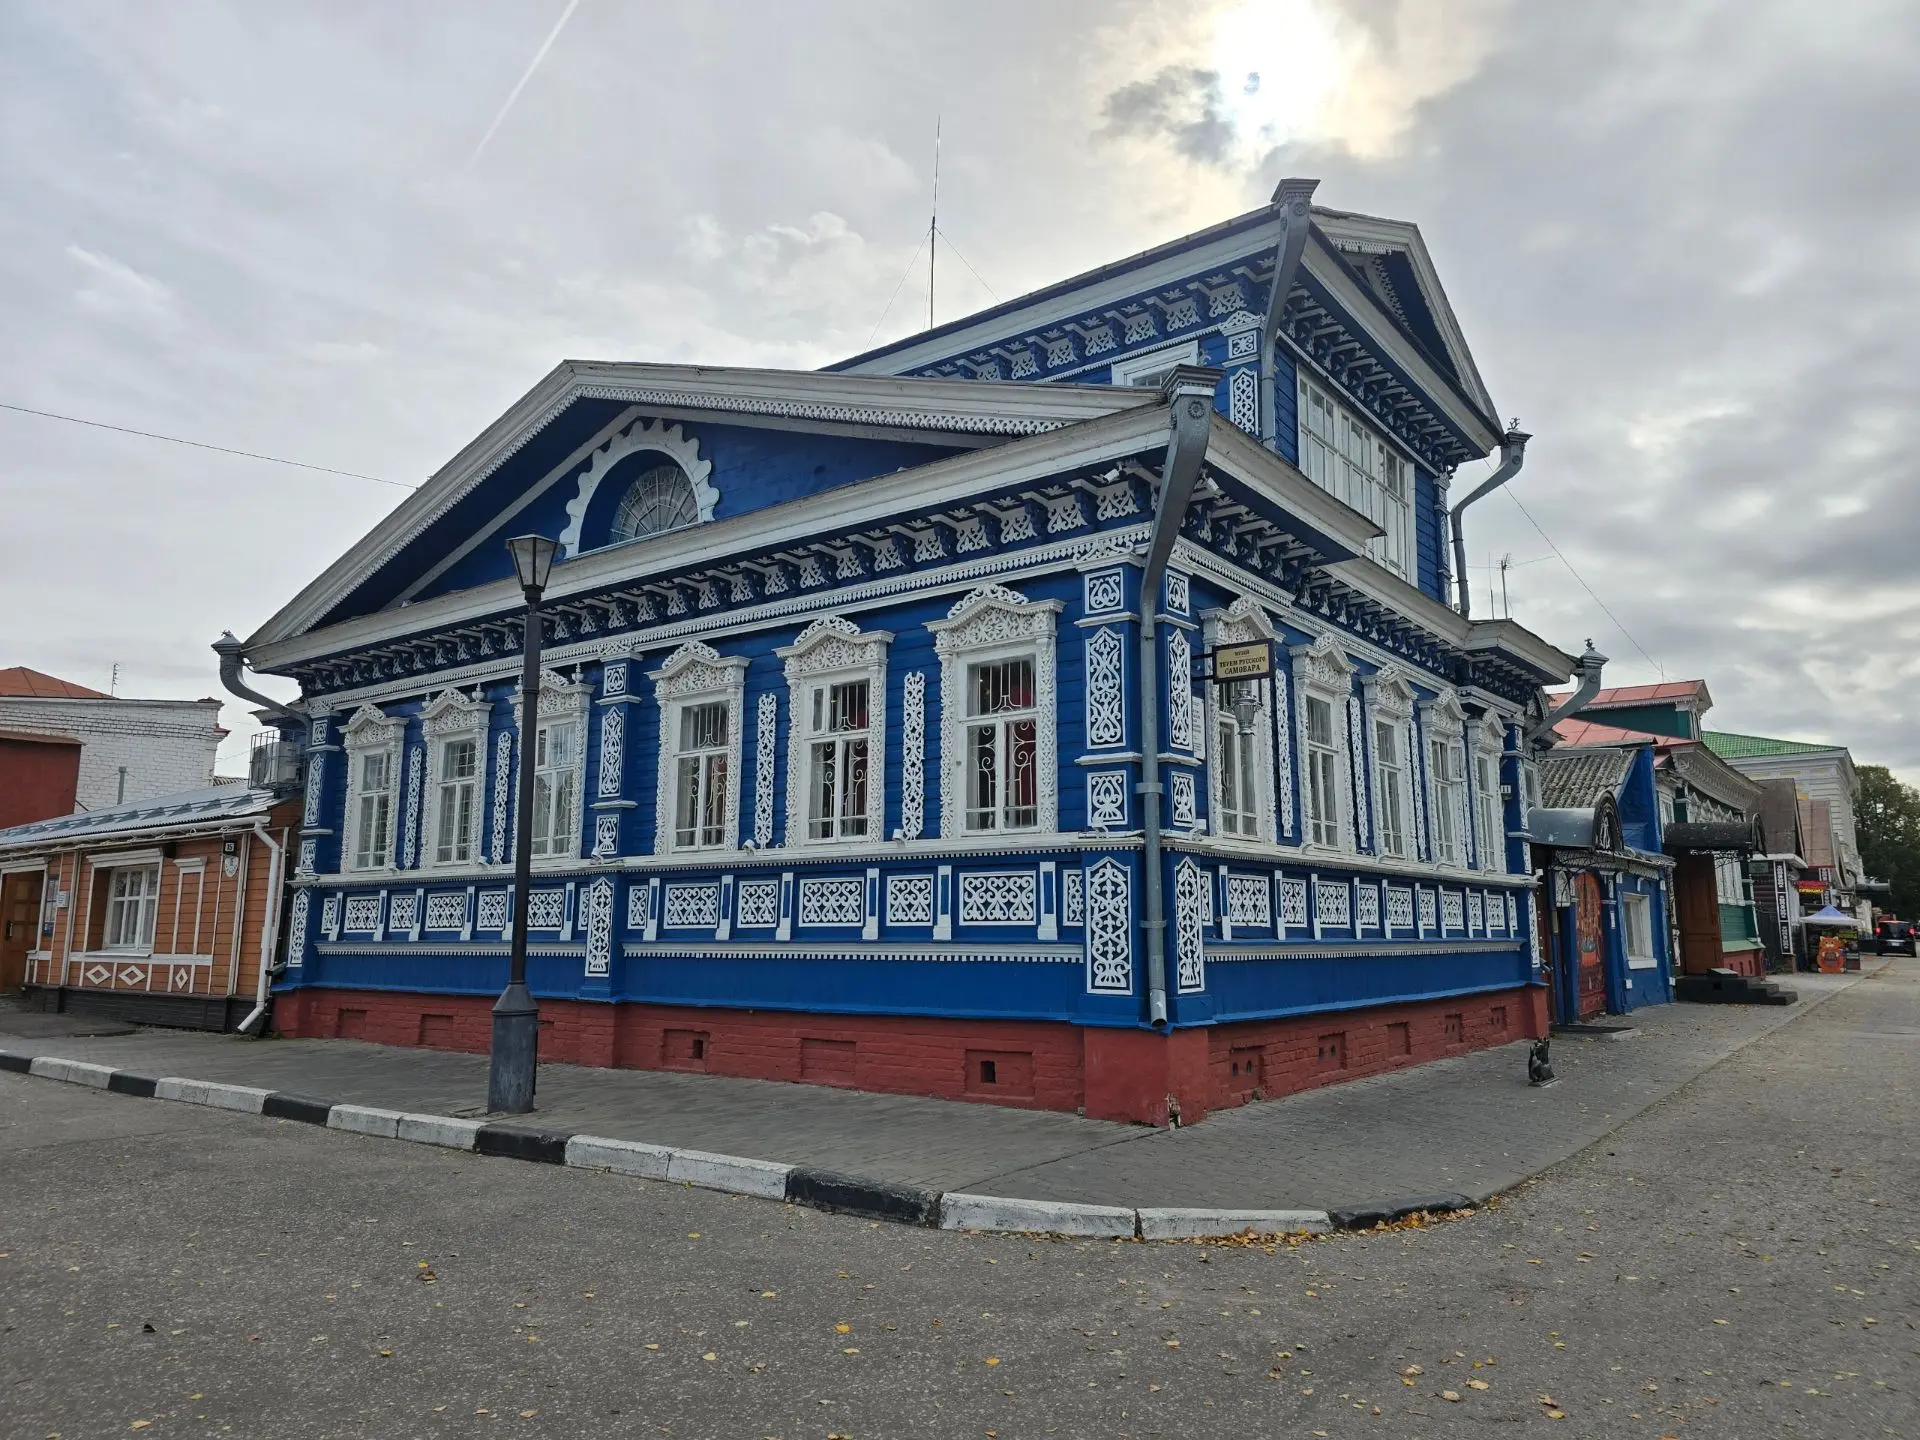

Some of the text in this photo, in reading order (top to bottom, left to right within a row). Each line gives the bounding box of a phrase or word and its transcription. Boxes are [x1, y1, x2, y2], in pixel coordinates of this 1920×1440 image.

[1219, 656, 1266, 668] ТЕРЕМ РУССКОГО
[1224, 664, 1261, 675] САМОВАРА
